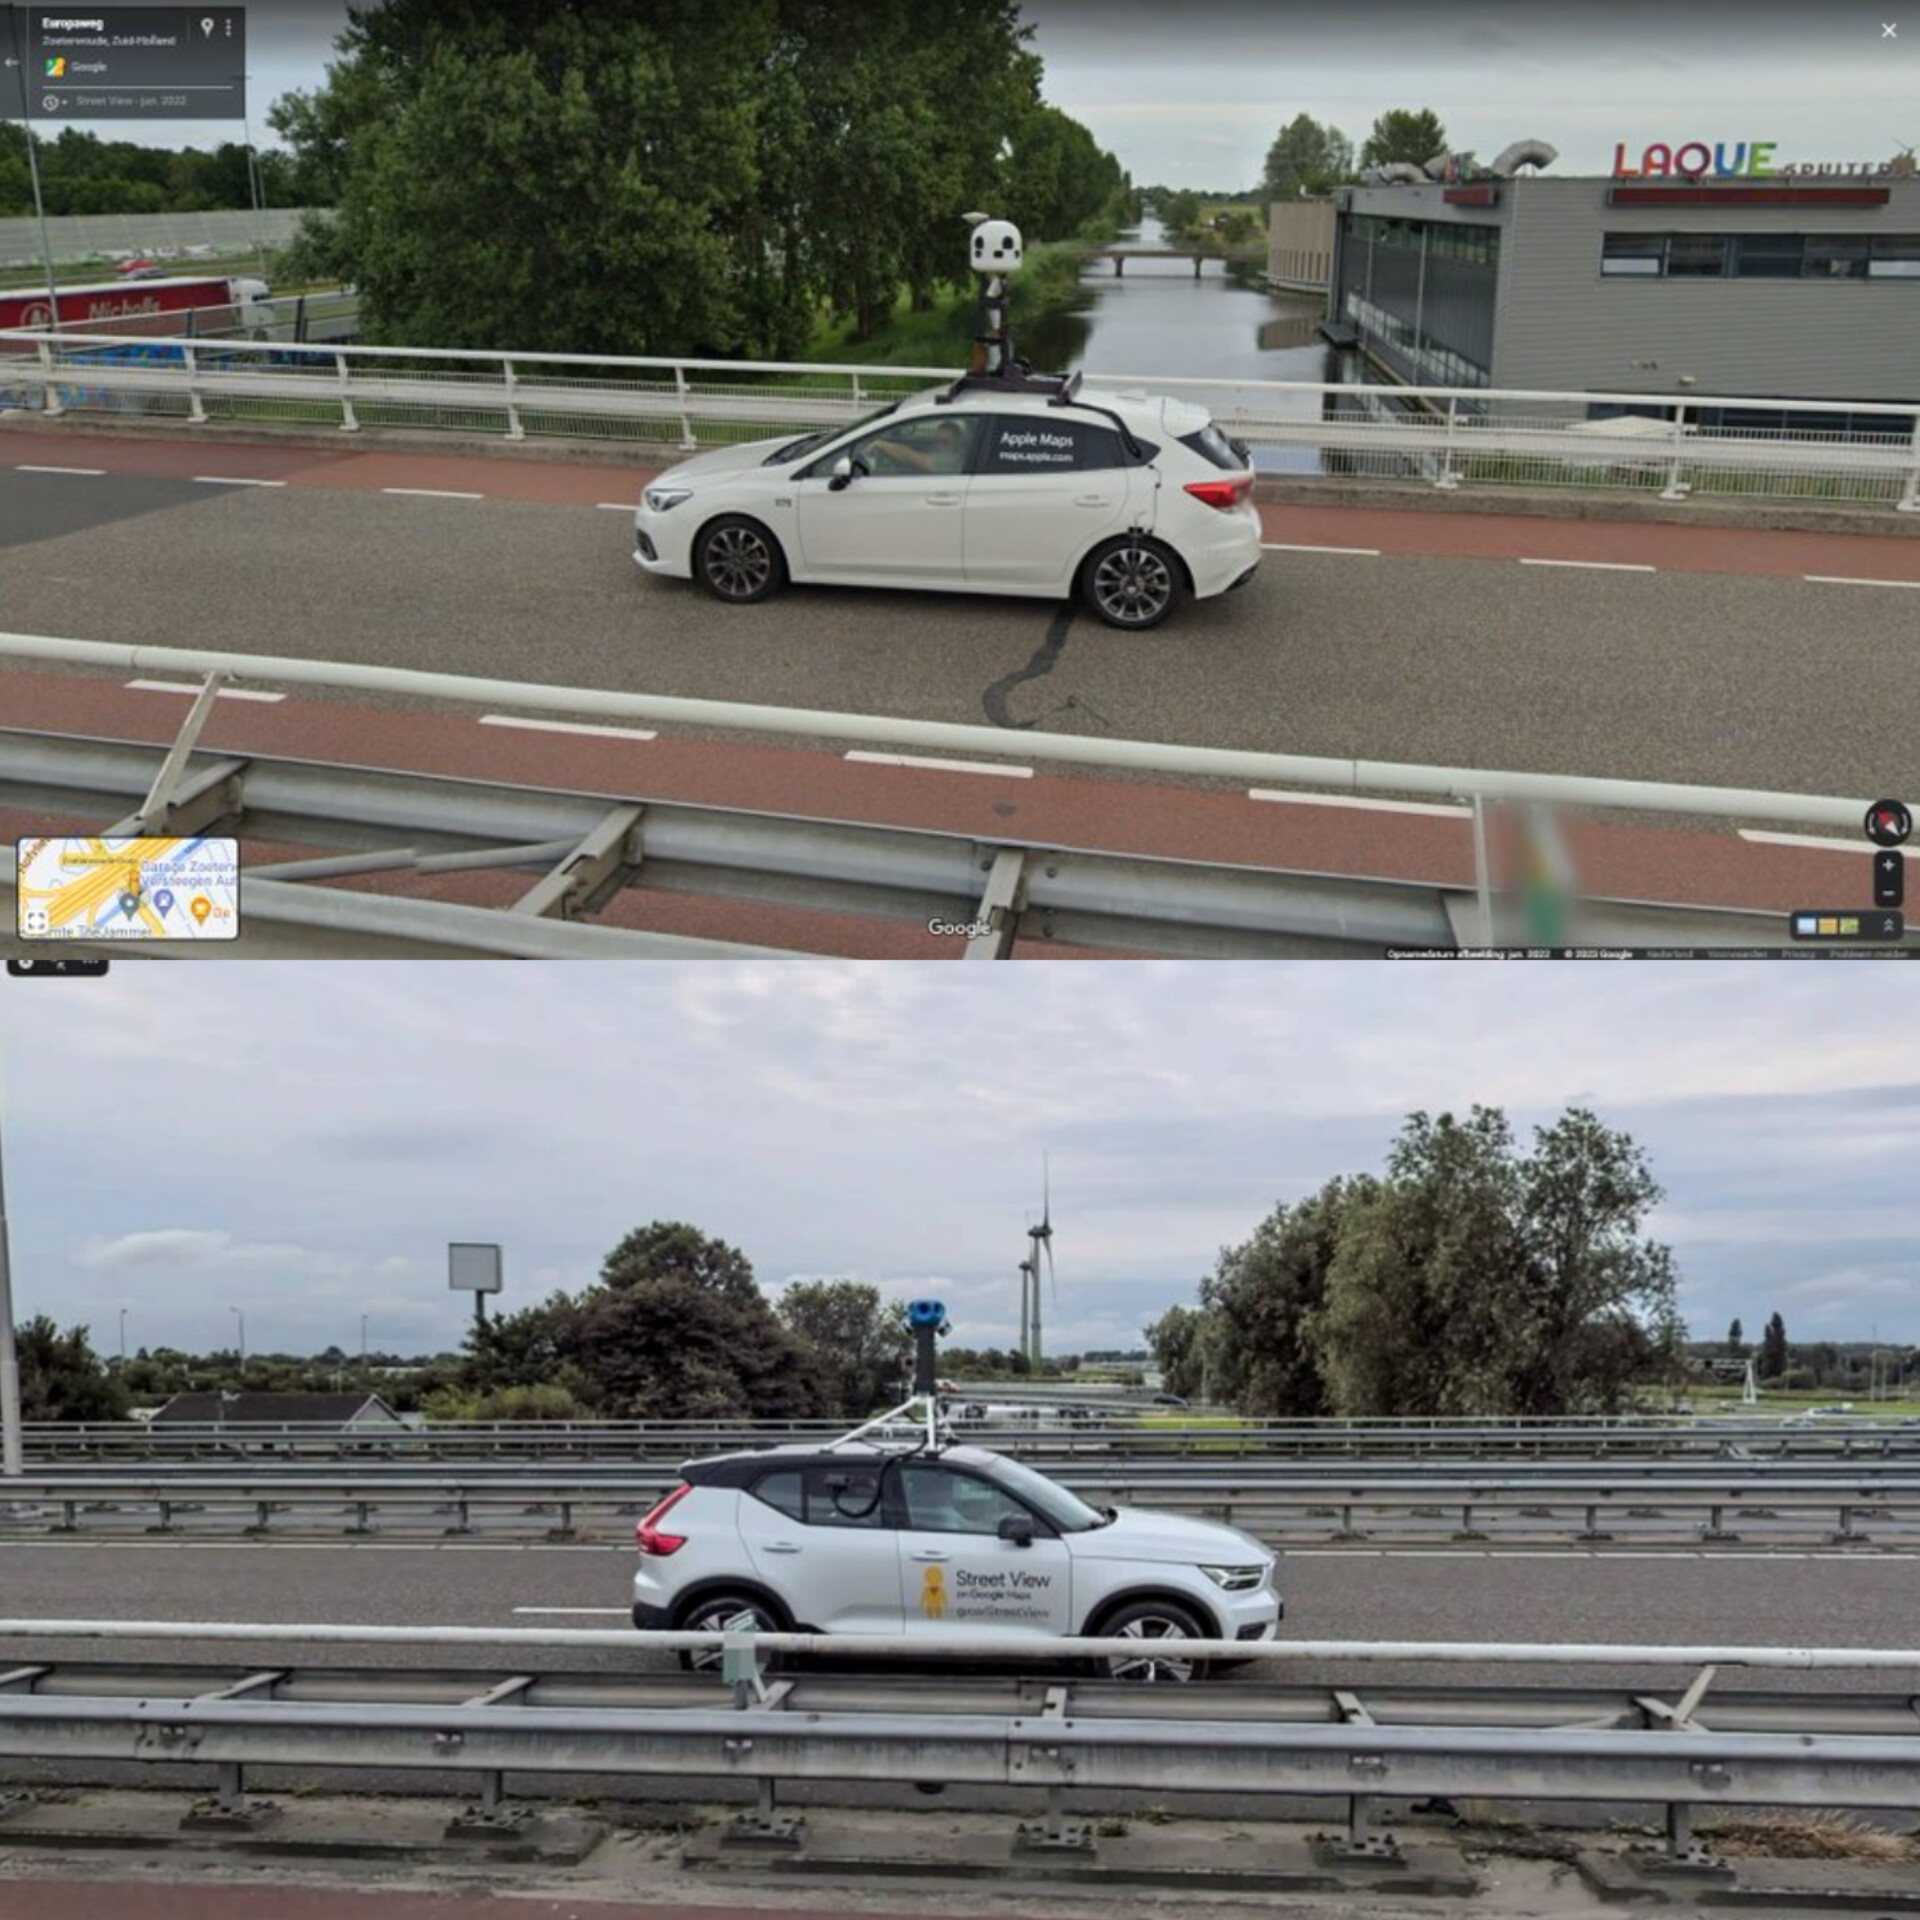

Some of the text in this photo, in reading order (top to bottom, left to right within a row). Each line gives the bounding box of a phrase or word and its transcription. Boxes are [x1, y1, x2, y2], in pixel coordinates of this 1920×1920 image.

[1612, 141, 1778, 184] LAQUE
[1000, 432, 1074, 448] Apple Maps
[956, 1569, 1051, 1588] Street View
[969, 1589, 1004, 1602] Google
[1006, 1590, 1032, 1601] Maps
